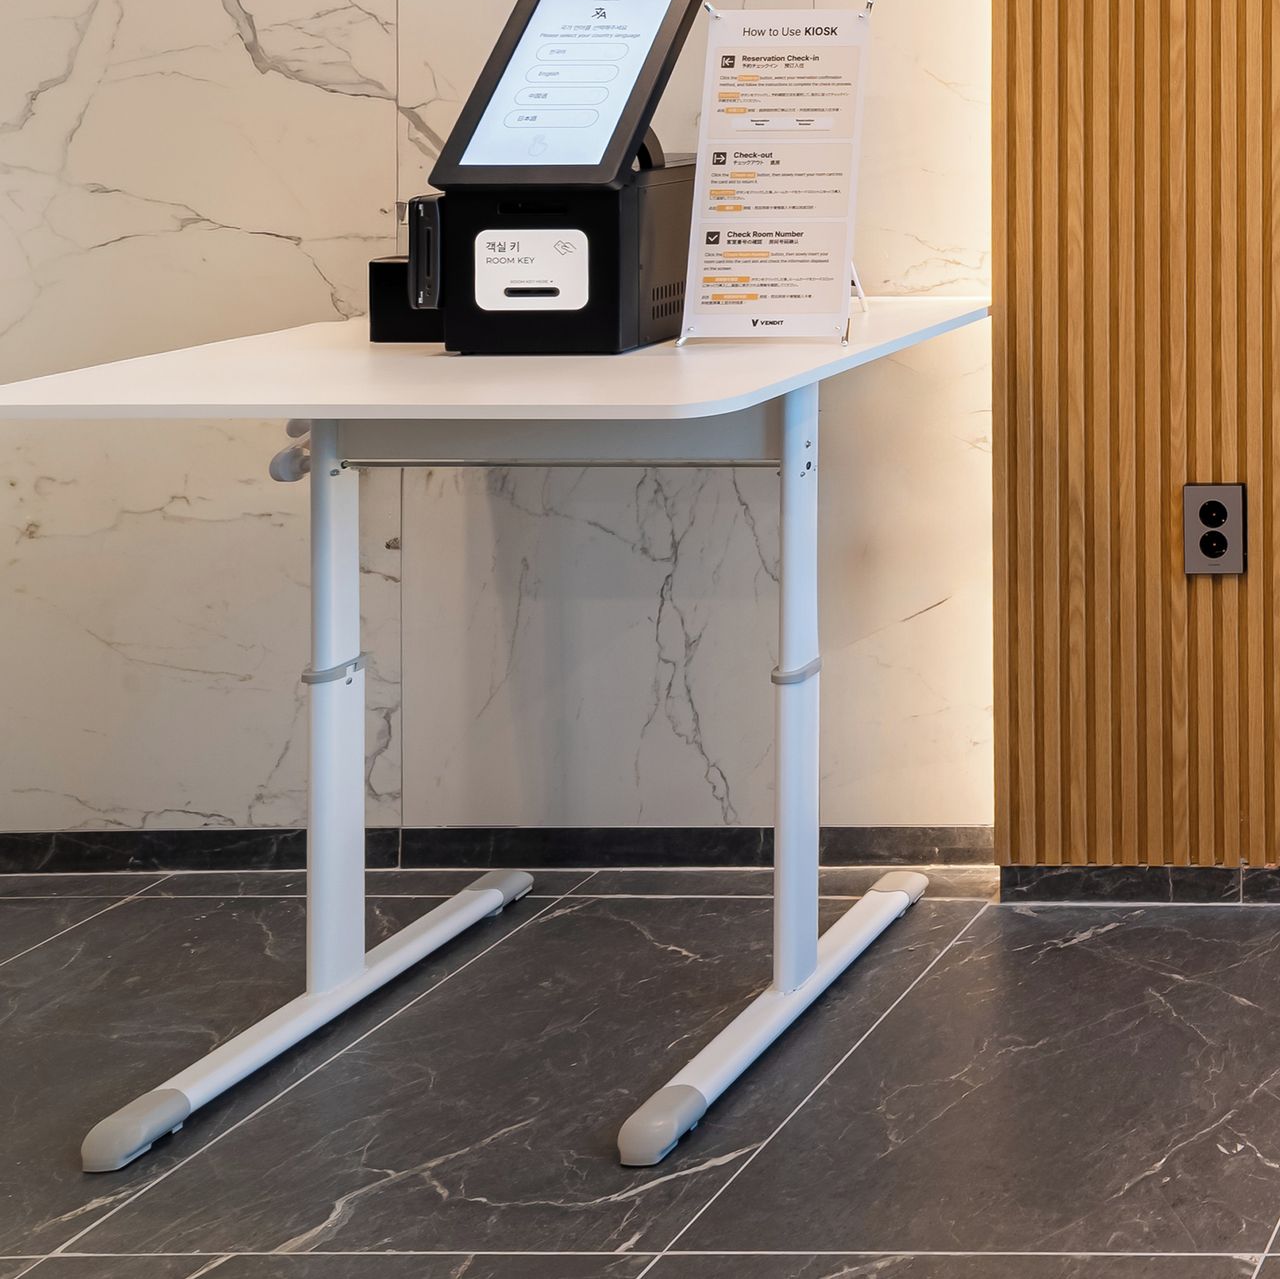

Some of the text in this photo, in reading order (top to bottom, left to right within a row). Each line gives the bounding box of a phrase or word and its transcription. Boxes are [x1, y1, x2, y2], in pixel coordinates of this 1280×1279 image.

[742, 26, 838, 37] How to Use KIOSK
[733, 151, 773, 159] Check-out
[486, 241, 520, 253] 객실 키
